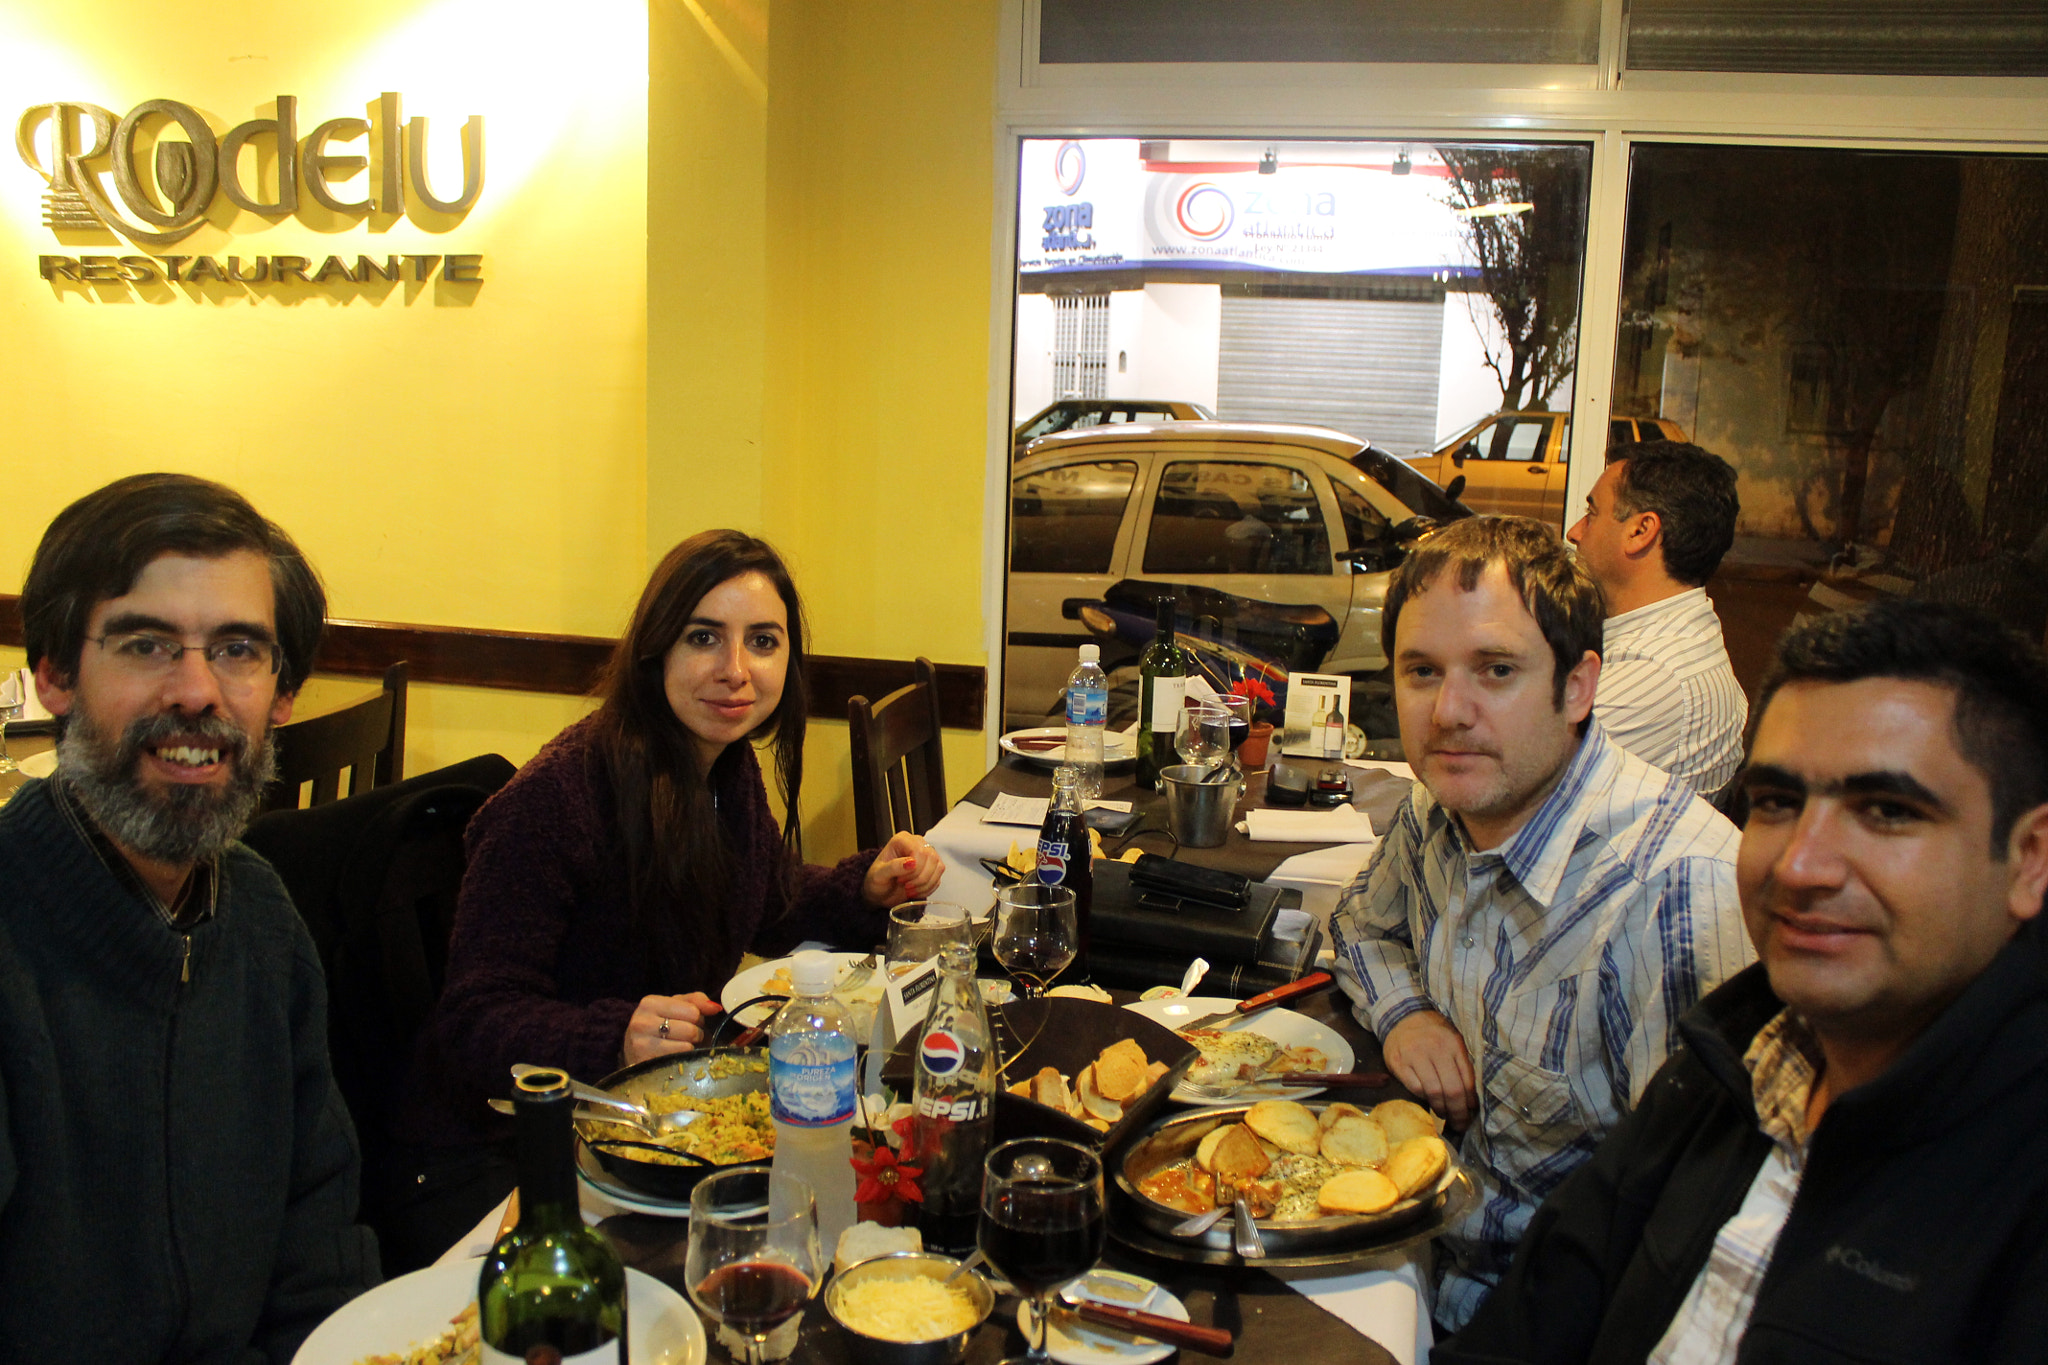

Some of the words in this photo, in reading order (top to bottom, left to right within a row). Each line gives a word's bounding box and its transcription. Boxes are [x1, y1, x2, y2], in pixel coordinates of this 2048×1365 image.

[1043, 202, 1093, 231] zona
[38, 253, 485, 284] RESTAURANTE
[1038, 839, 1068, 858] EPSI
[801, 1066, 836, 1077] PUREZA
[919, 1096, 977, 1122] EPSI
